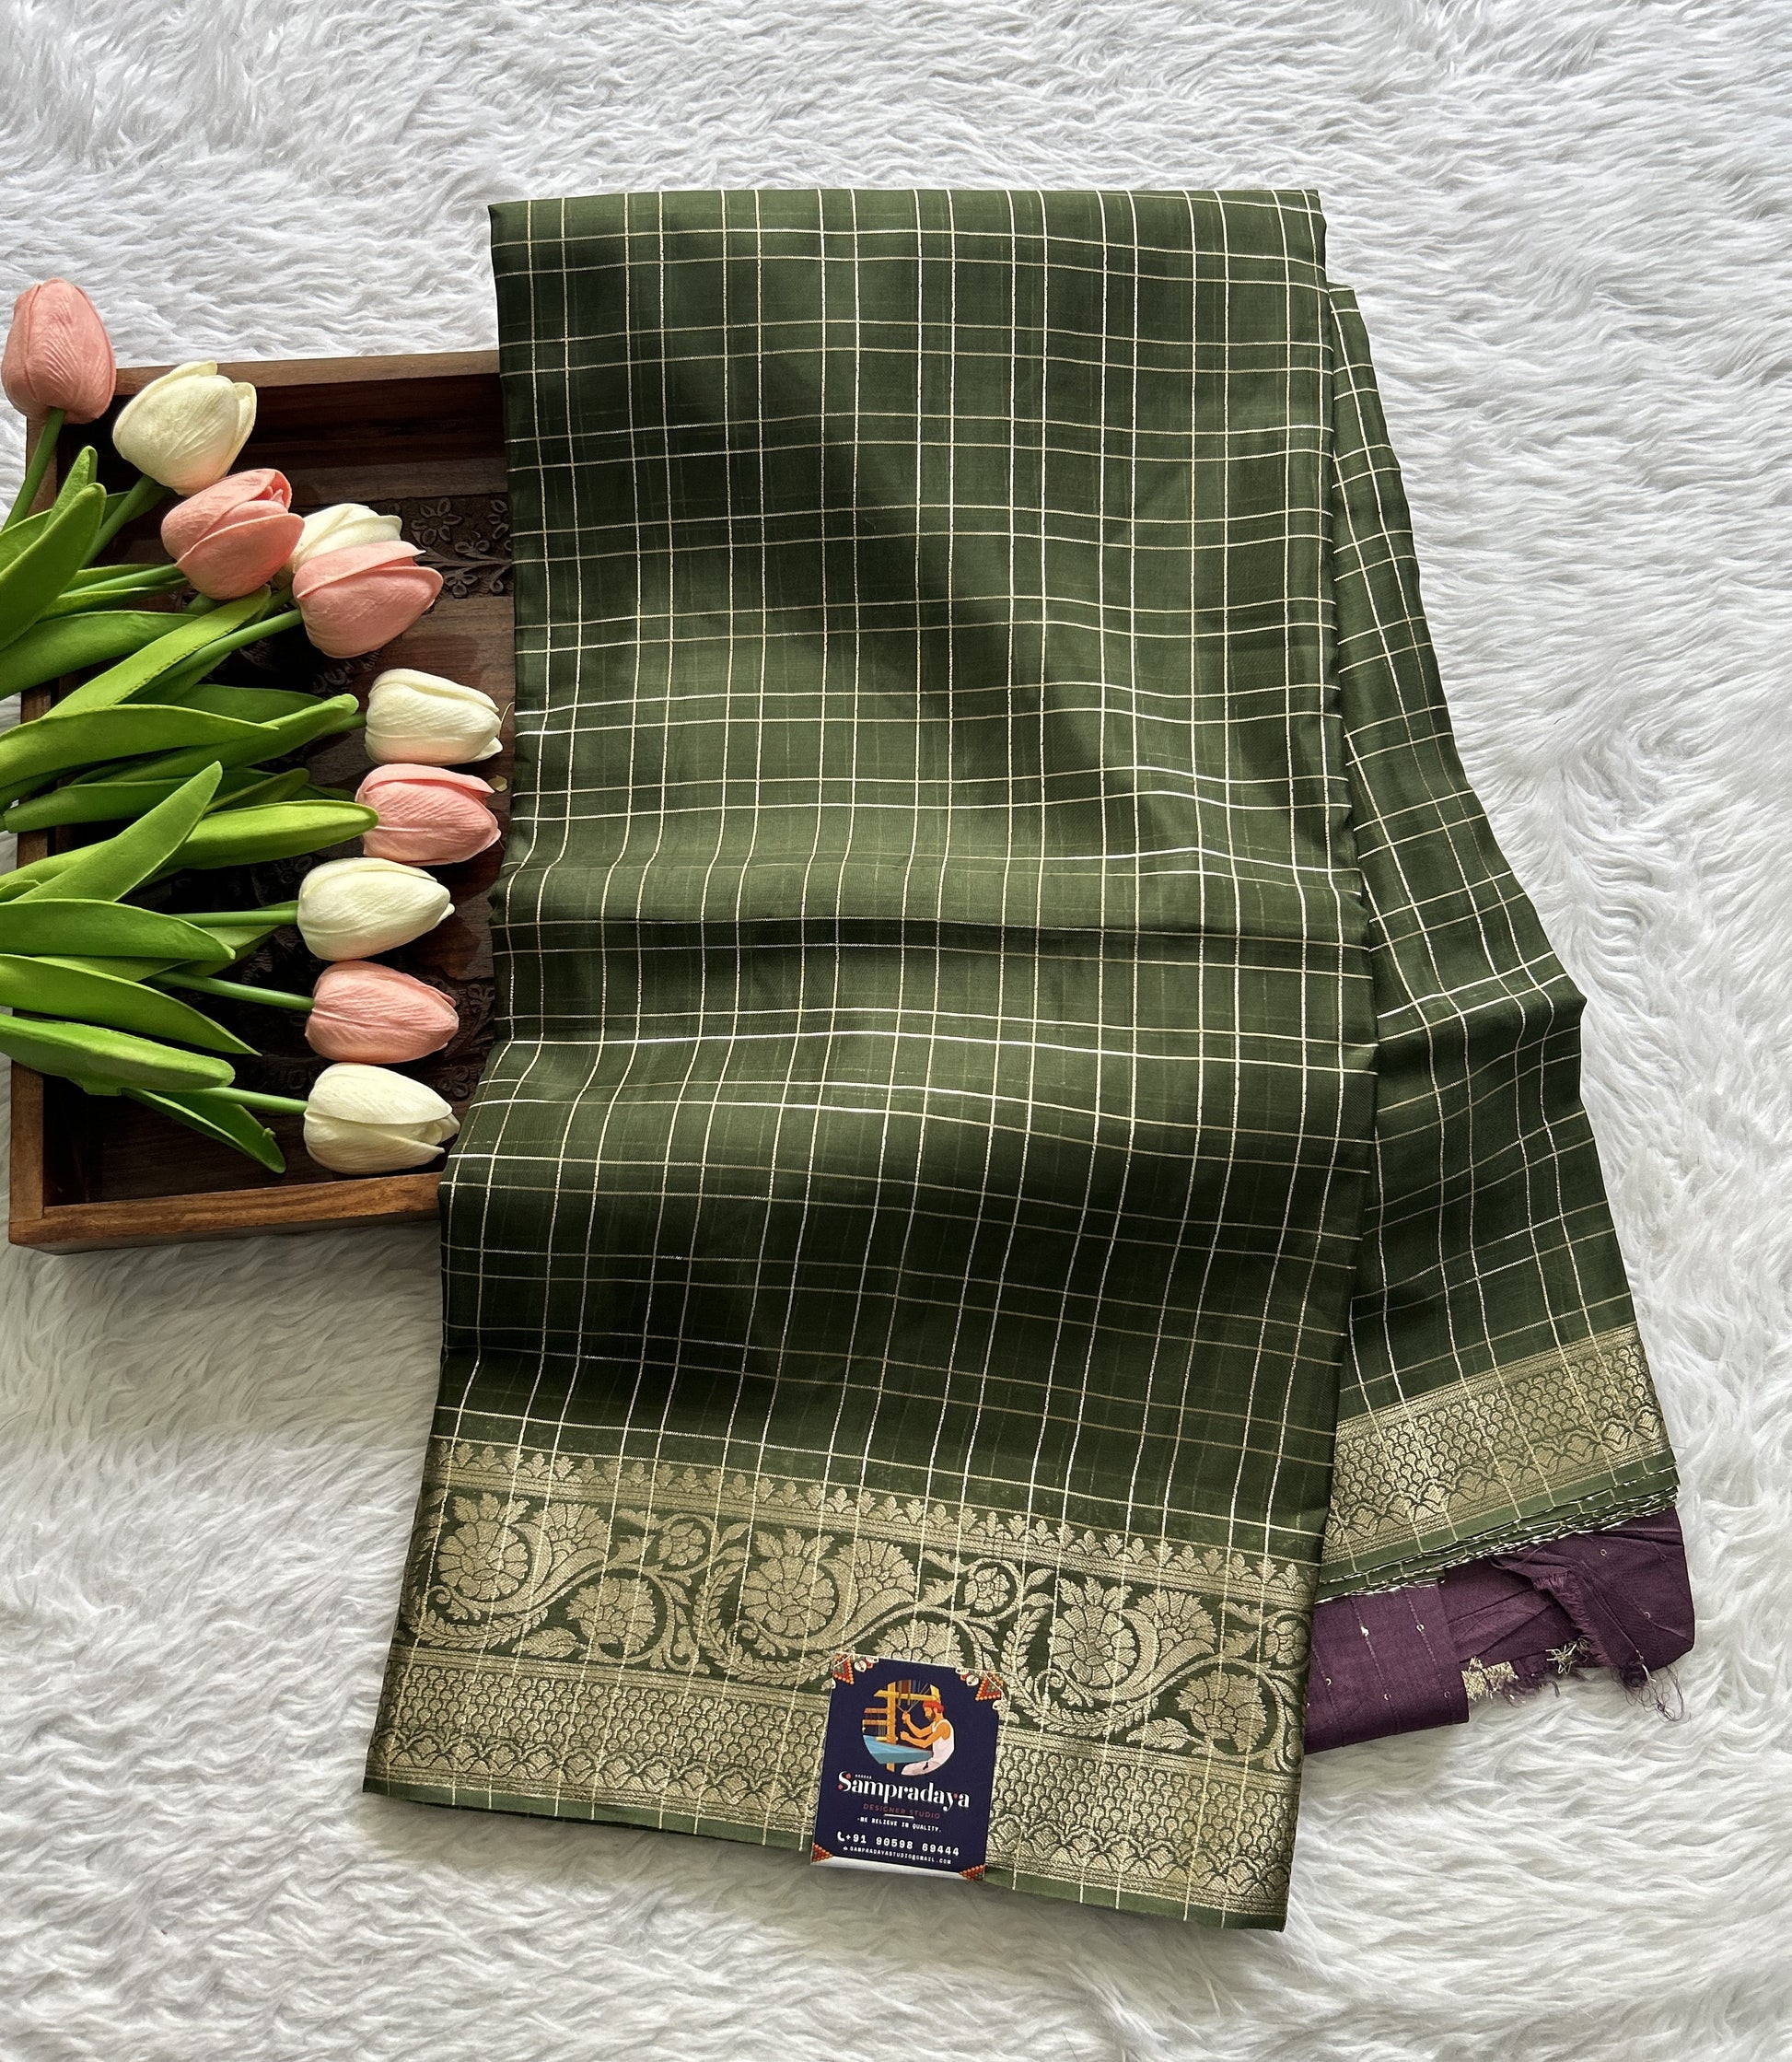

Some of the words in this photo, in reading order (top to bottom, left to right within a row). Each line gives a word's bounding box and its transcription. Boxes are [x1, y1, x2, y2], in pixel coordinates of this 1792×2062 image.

[838, 1771, 970, 1812] Sampradaya
[863, 1803, 906, 1814] DESIGNER
[909, 1810, 941, 1819] STUDIO
[871, 1817, 898, 1826] BELIEVE
[845, 1834, 867, 1844] +91
[876, 1836, 913, 1849] 90598
[922, 1843, 960, 1857] 69444
